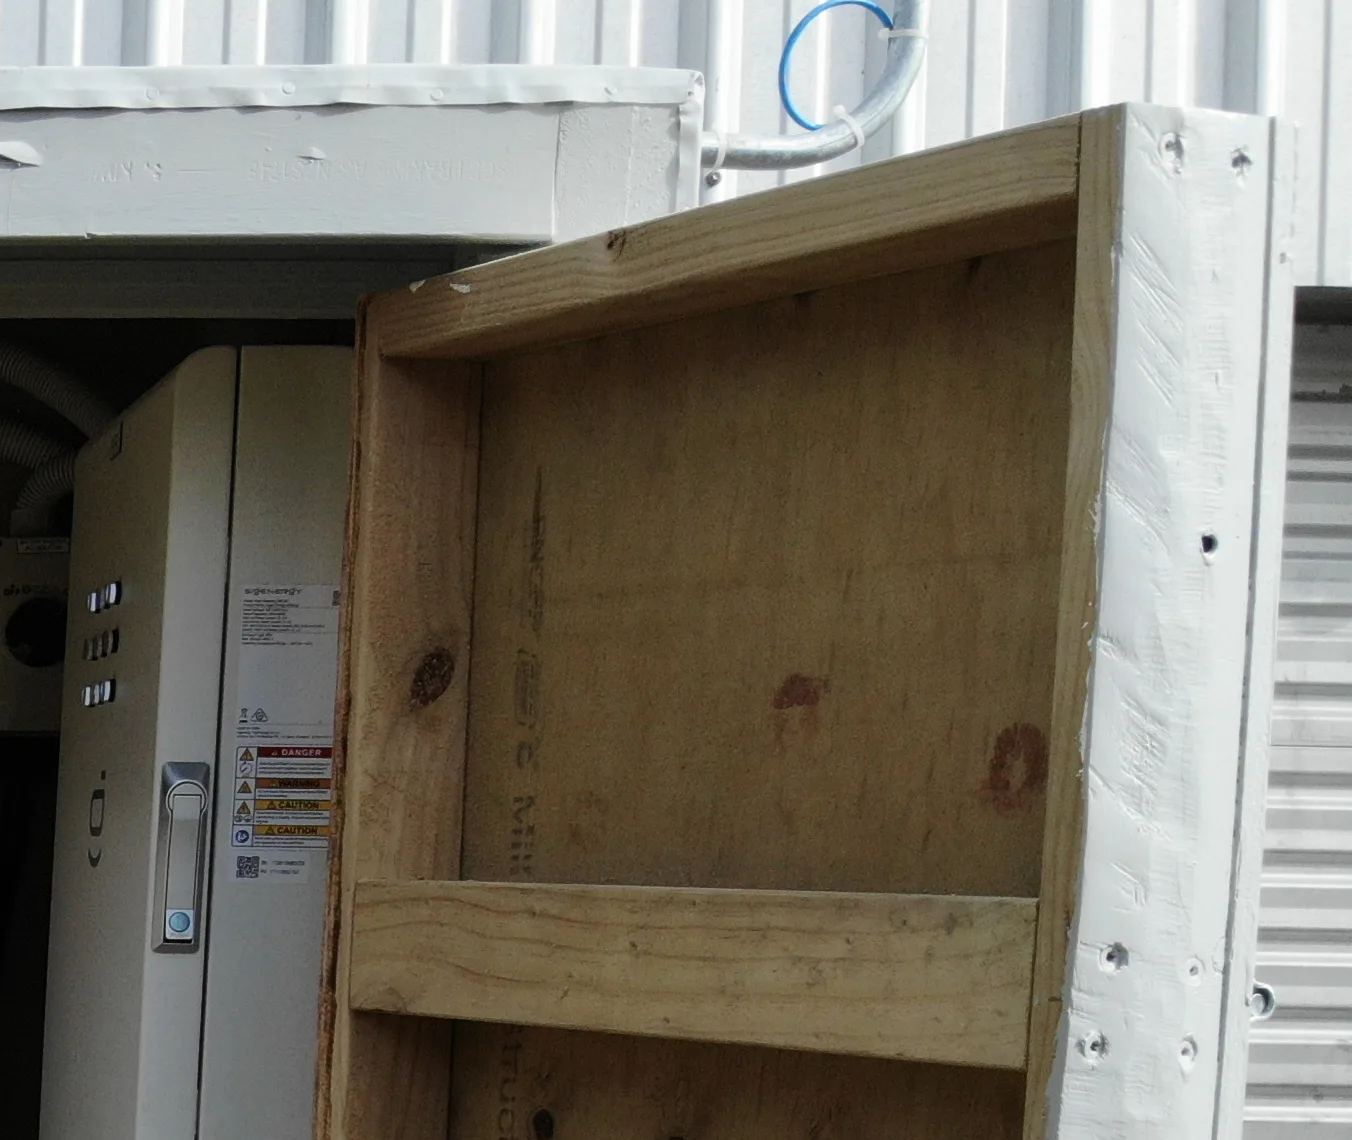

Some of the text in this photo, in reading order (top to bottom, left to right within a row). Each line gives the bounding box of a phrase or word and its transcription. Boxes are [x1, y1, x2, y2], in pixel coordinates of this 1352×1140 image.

[281, 748, 322, 756] DANGER
[278, 801, 319, 810] CAUTION
[276, 826, 317, 835] CAUTION
